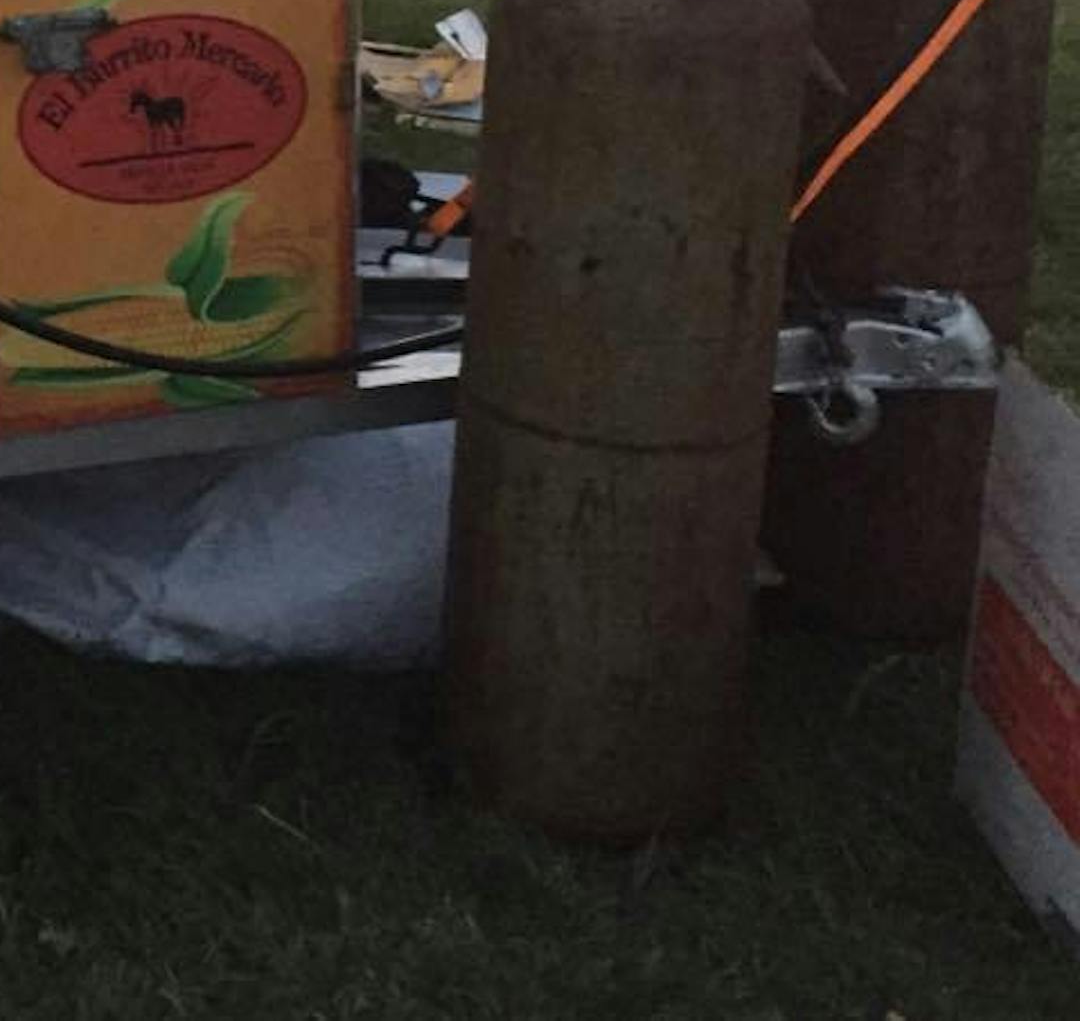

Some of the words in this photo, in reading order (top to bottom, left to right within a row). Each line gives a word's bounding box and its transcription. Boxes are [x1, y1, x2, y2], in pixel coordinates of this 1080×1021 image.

[37, 92, 75, 132] El
[74, 37, 171, 98] Burrito
[179, 30, 287, 107] Mercado
